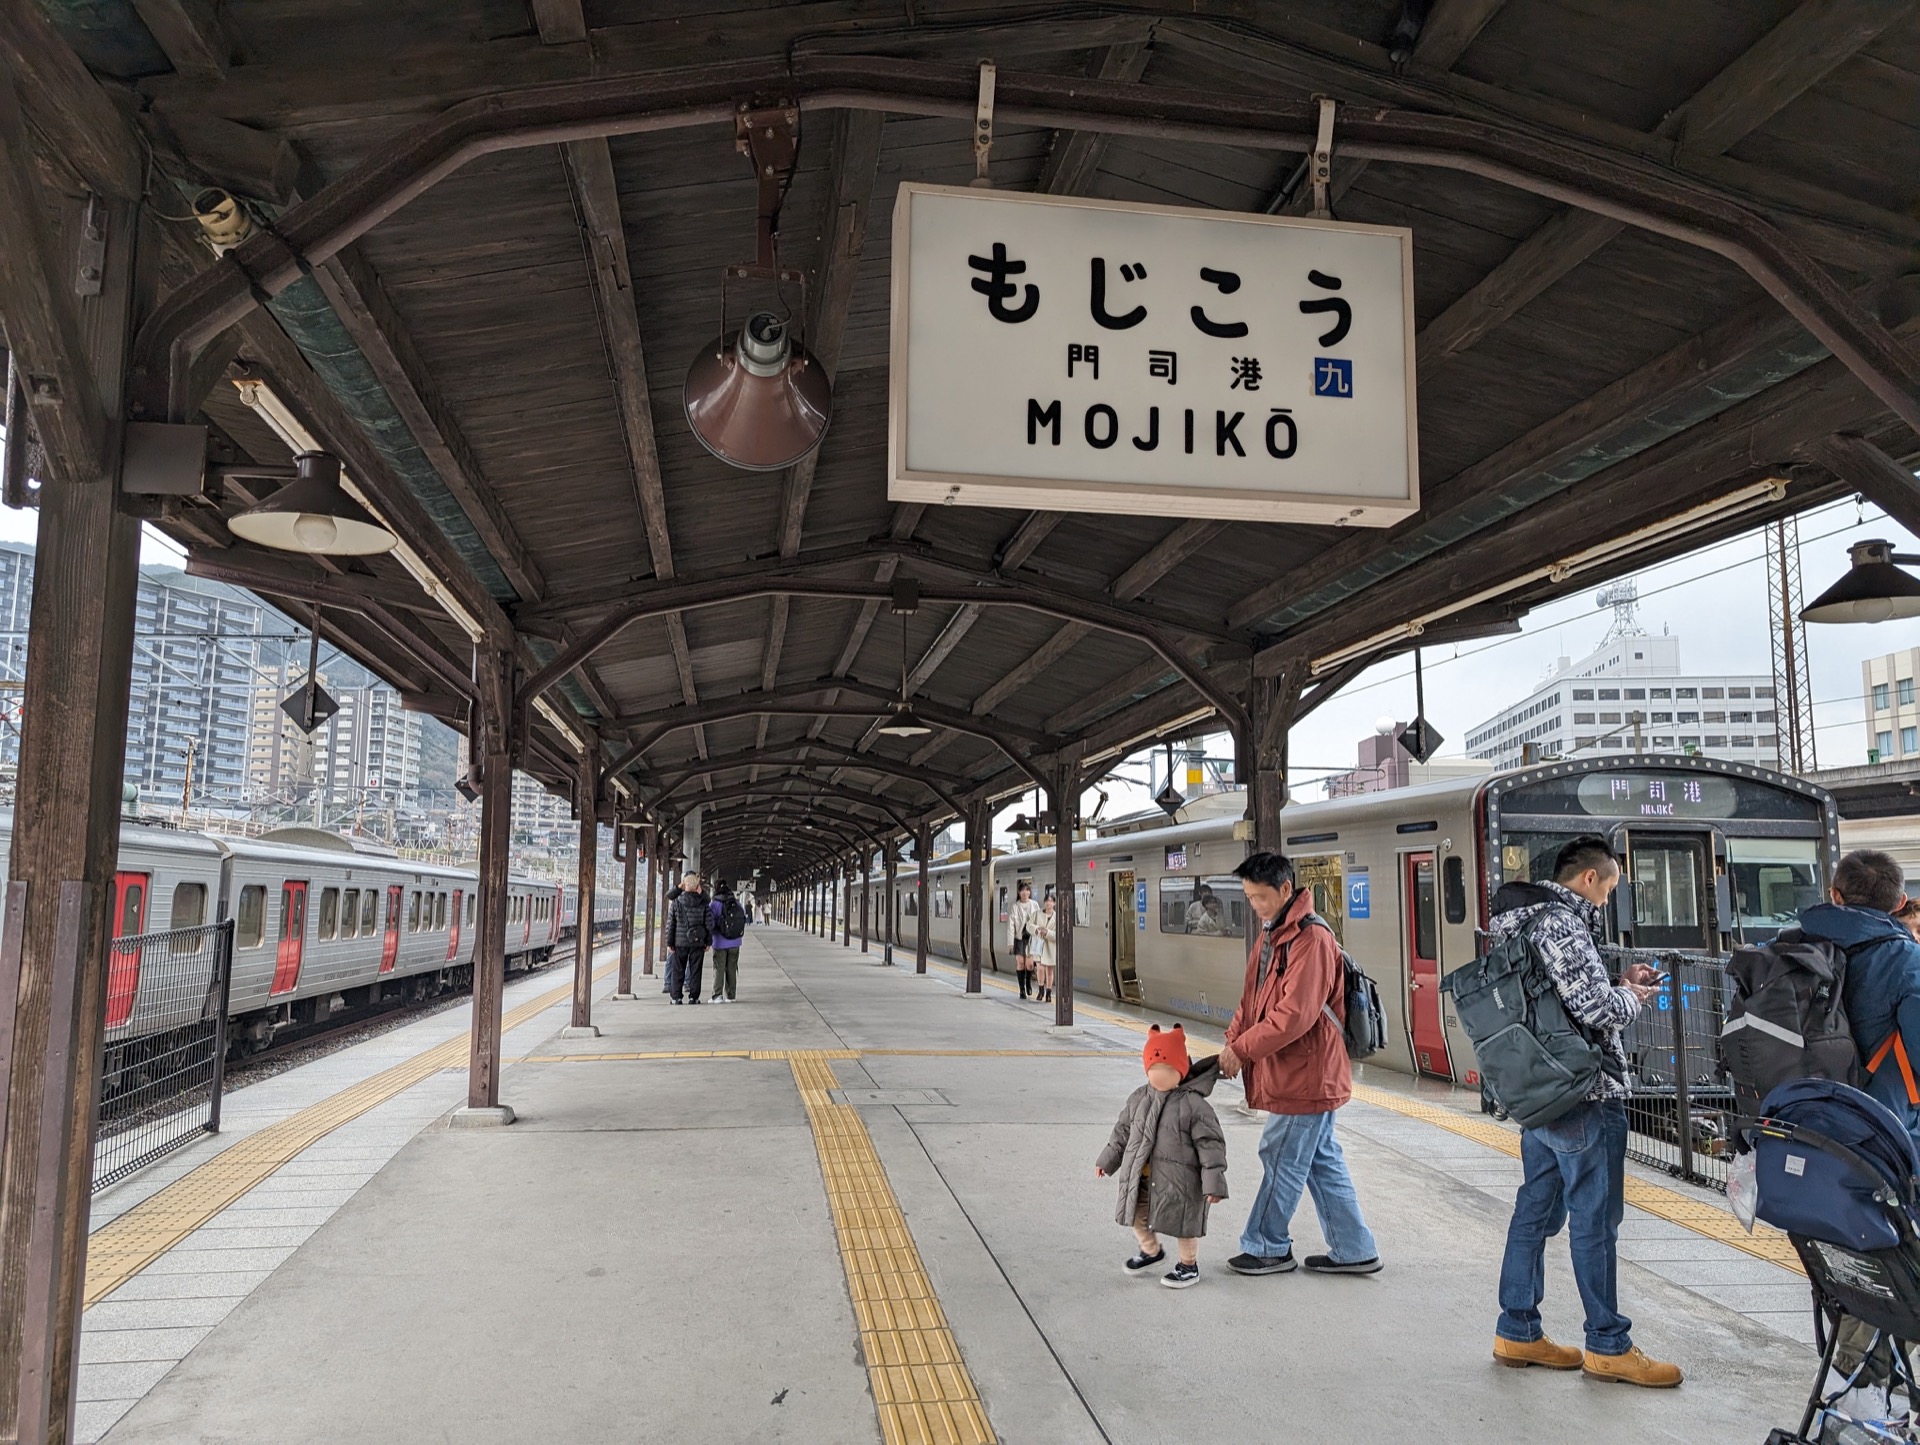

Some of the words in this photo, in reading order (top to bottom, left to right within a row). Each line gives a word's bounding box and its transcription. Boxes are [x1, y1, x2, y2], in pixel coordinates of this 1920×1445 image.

[968, 242, 1352, 347] もじこう
[1067, 343, 1263, 392] 門司港
[1318, 361, 1350, 395] 九
[1027, 398, 1298, 460] MOJIKŌ
[1611, 779, 1701, 803] 門司港
[1351, 882, 1366, 905] CT
[1465, 1070, 1479, 1085] JR
